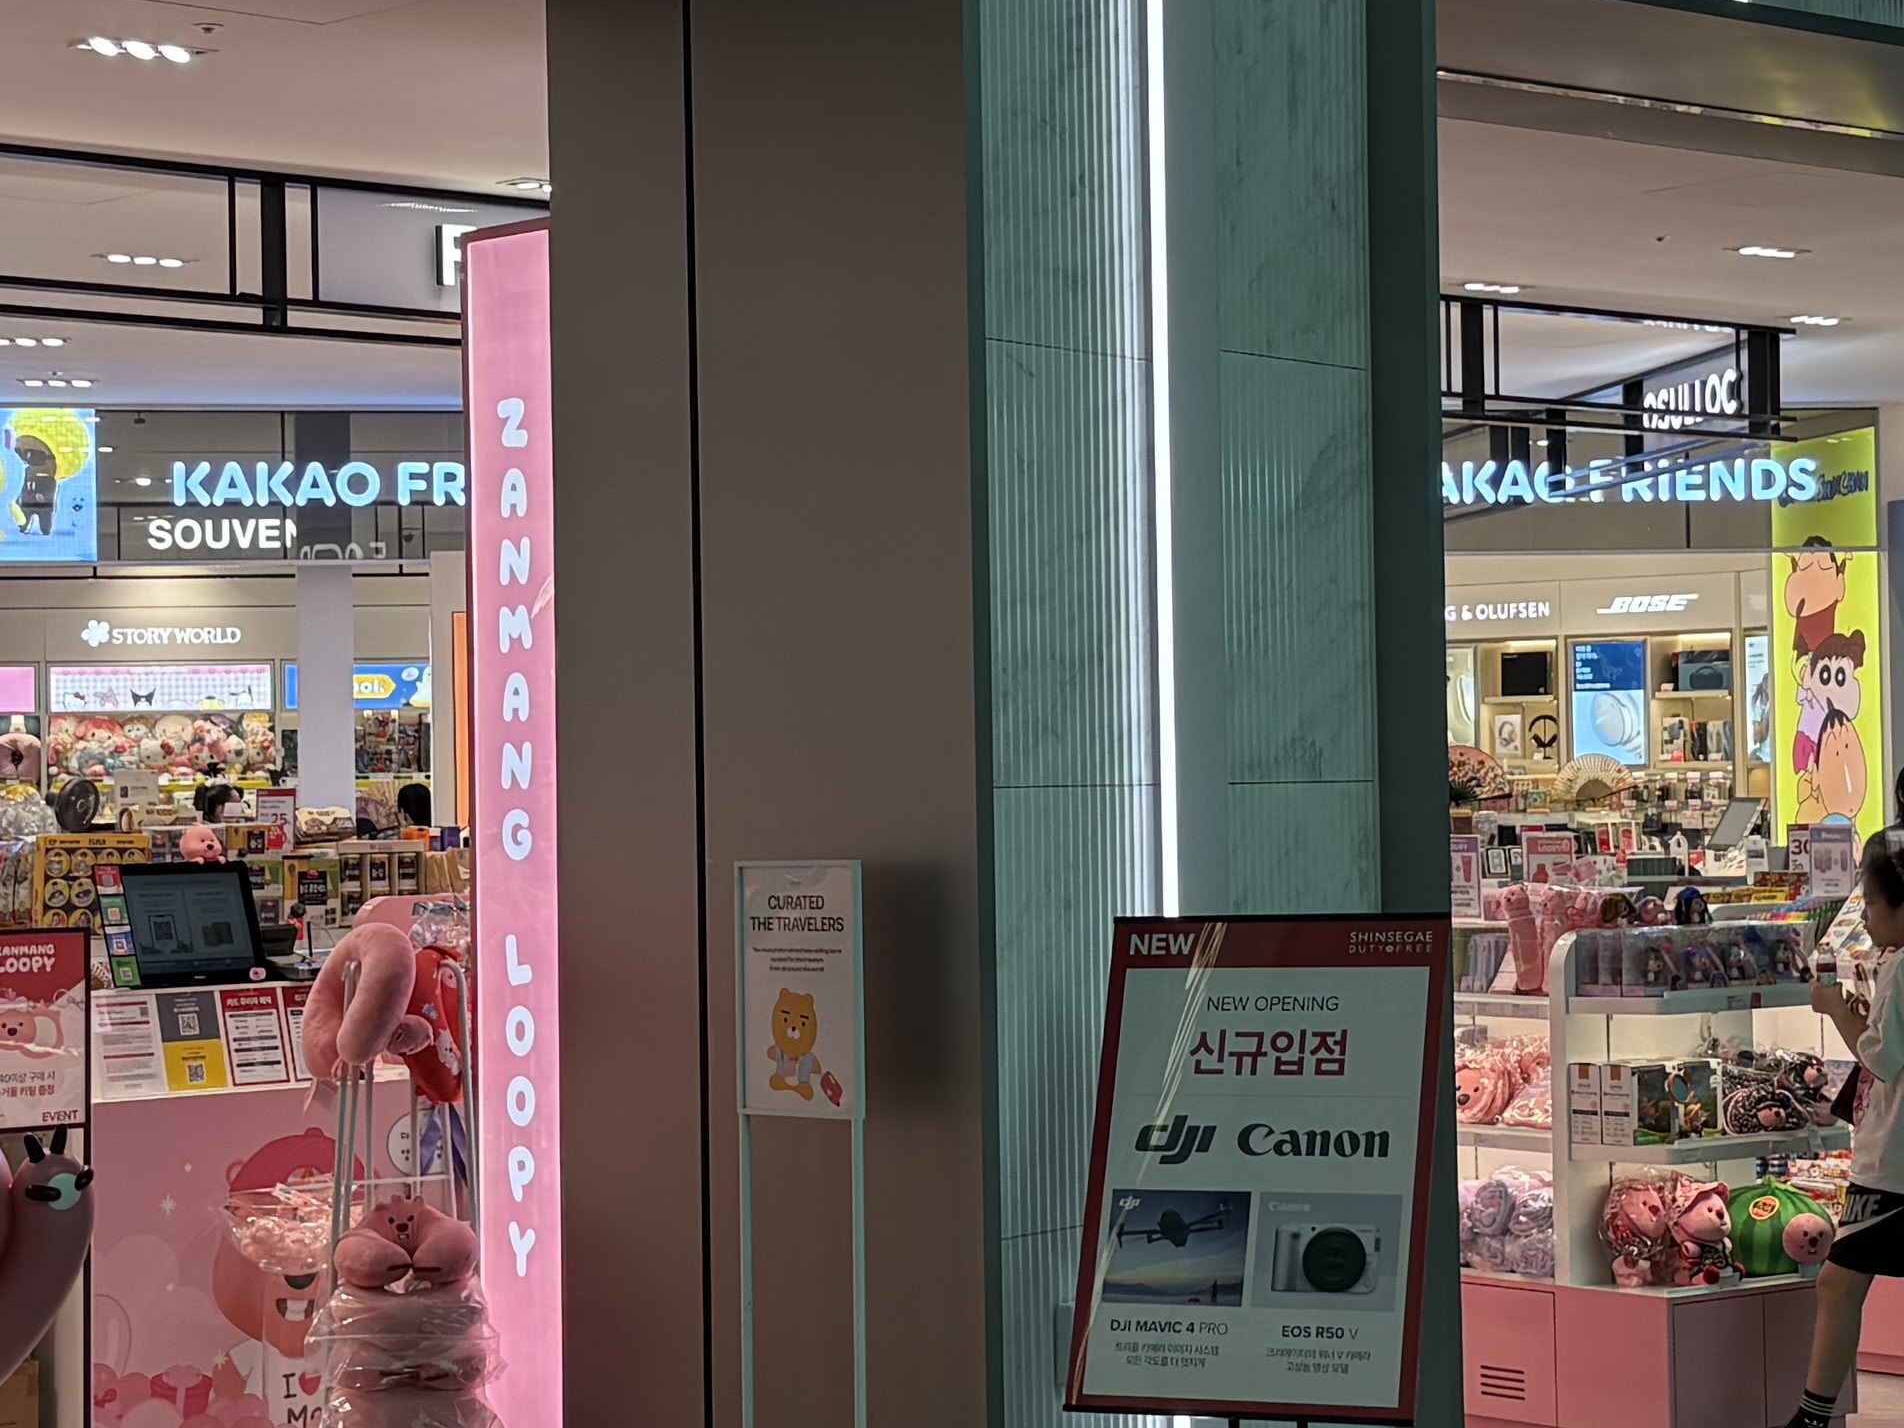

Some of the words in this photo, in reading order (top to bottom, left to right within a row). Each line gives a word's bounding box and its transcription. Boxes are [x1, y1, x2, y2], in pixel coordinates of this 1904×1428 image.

[173, 461, 381, 508] KAKAO
[397, 461, 466, 507] FR
[147, 518, 297, 551] SOUVE
[1476, 601, 1550, 619] OLUFSEN
[1597, 593, 1699, 614] BOSE
[496, 396, 534, 863] ZANMANG
[768, 894, 825, 910] CURATED
[750, 916, 774, 932] THE
[776, 916, 845, 933] TRAVELERS
[1129, 933, 1196, 956] NEW
[1350, 931, 1433, 943] SHINSEGAE
[1348, 944, 1386, 954] DUTY
[1395, 944, 1433, 954] FREE
[1206, 996, 1250, 1012] NEW
[1254, 995, 1340, 1012] OPENING
[1189, 1028, 1349, 1077] 신규입점
[505, 932, 536, 1277] LOOPY
[42, 1110, 79, 1122] EVENT
[1237, 1123, 1390, 1158] Canon
[1268, 1201, 1311, 1212] Canon
[1110, 1318, 1132, 1333] DJI
[1134, 1320, 1184, 1334] MAVIC
[1185, 1320, 1195, 1334] 4
[1198, 1322, 1229, 1336] PRO
[1281, 1325, 1312, 1338] EOS
[1315, 1326, 1345, 1340] R50
[1349, 1328, 1359, 1340] V
